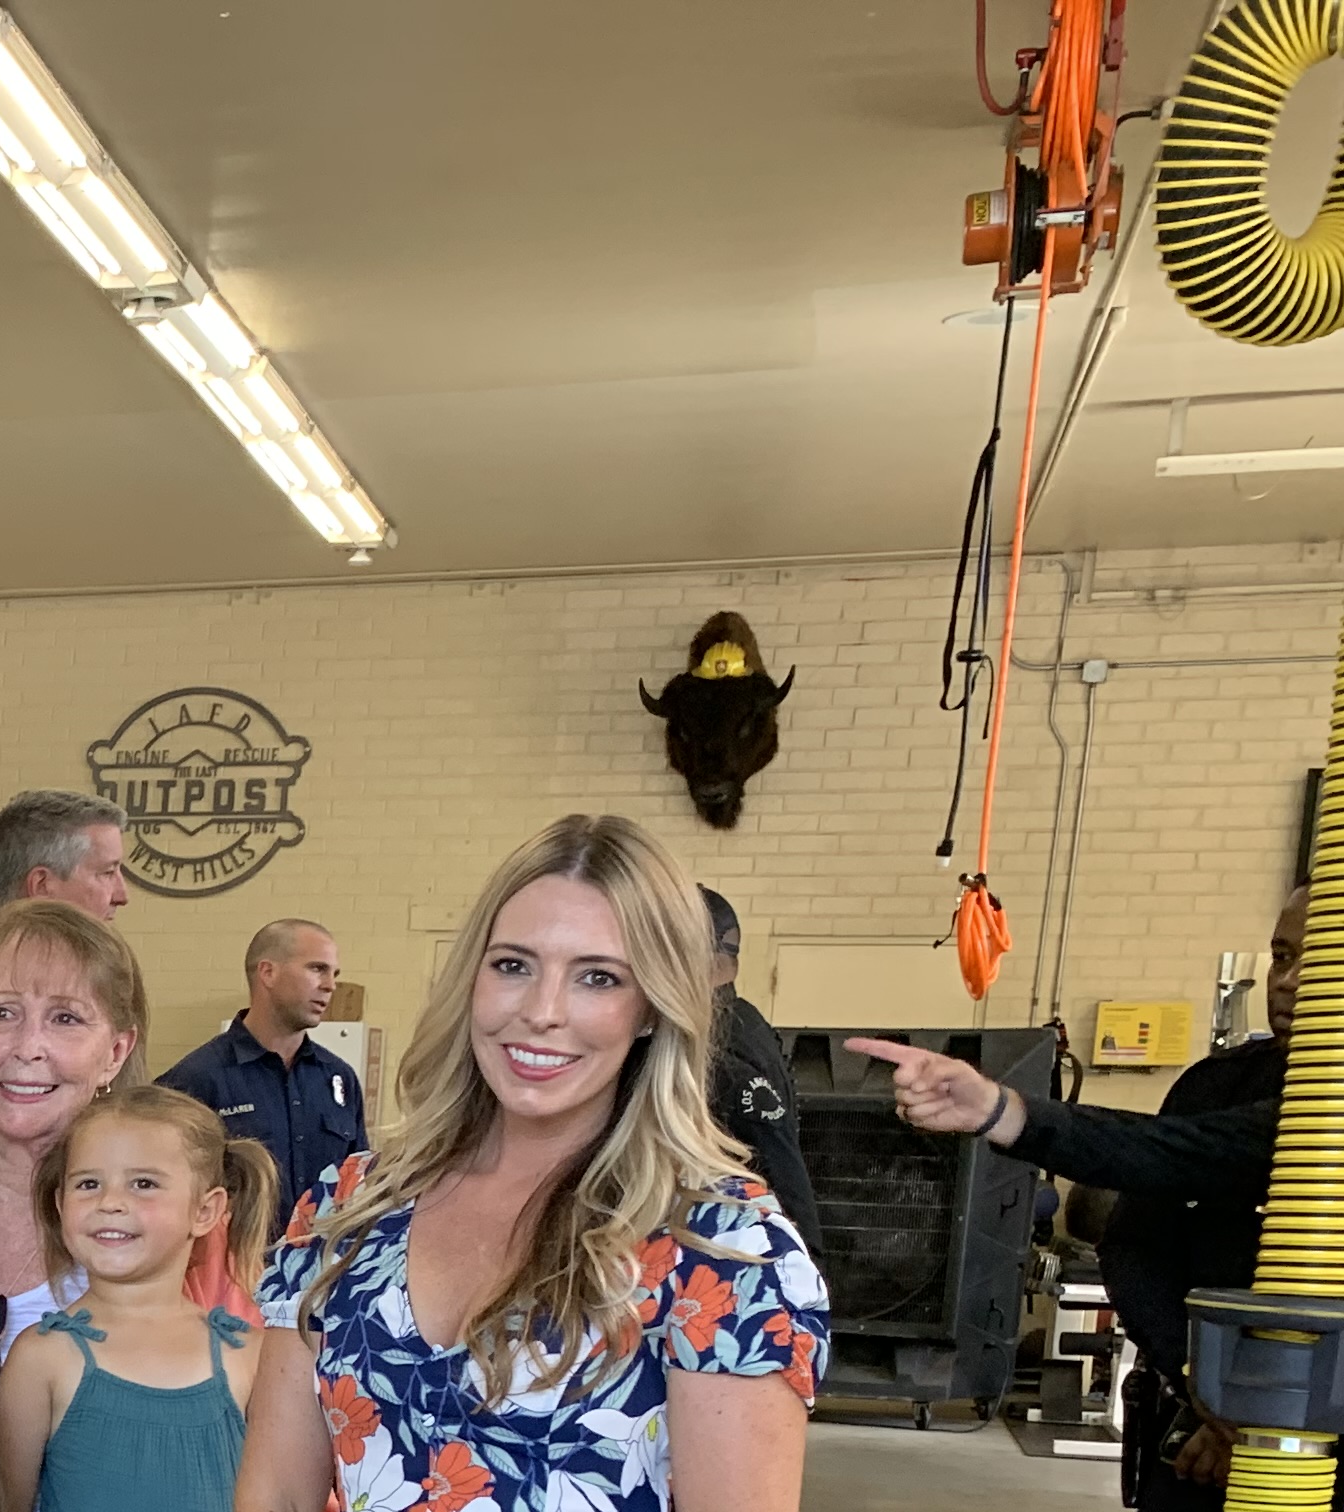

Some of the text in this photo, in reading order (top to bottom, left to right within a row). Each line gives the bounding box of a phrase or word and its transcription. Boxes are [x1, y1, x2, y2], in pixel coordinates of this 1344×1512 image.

[148, 703, 252, 735] LAFD
[116, 747, 280, 765] ENGINE RESCUE
[173, 766, 218, 778] THE LAST
[128, 840, 255, 883] WEST HILLS
[741, 1089, 754, 1113] LOS
